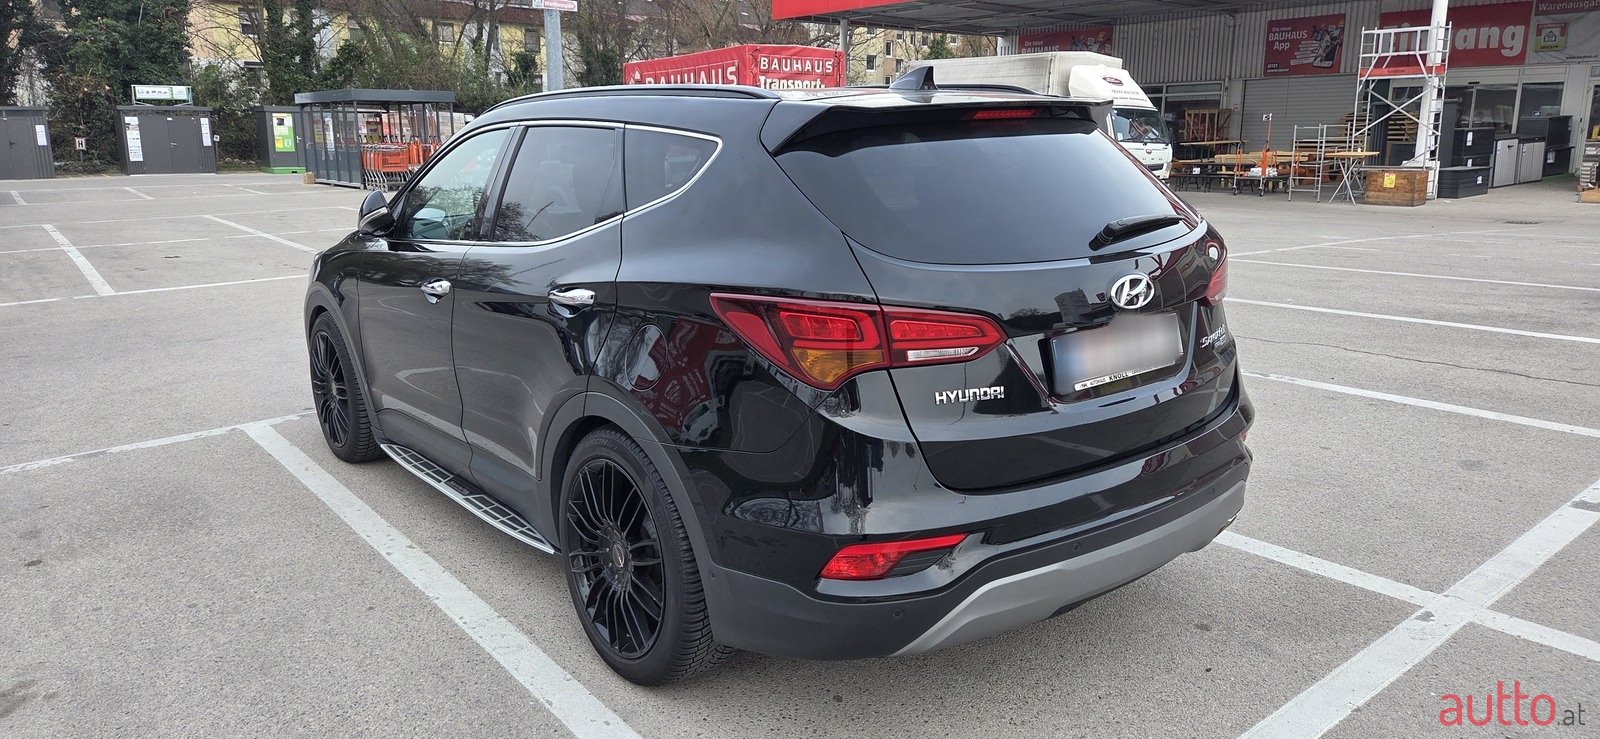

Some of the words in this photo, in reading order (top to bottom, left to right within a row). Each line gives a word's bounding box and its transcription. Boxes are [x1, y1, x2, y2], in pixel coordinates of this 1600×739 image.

[1268, 30, 1308, 41] BAUHAUS
[1273, 41, 1290, 51] App
[760, 57, 833, 73] BAUHAUS
[78, 140, 83, 148] H
[1109, 371, 1129, 382] KNOLL
[935, 386, 1005, 405] HYUNDAI
